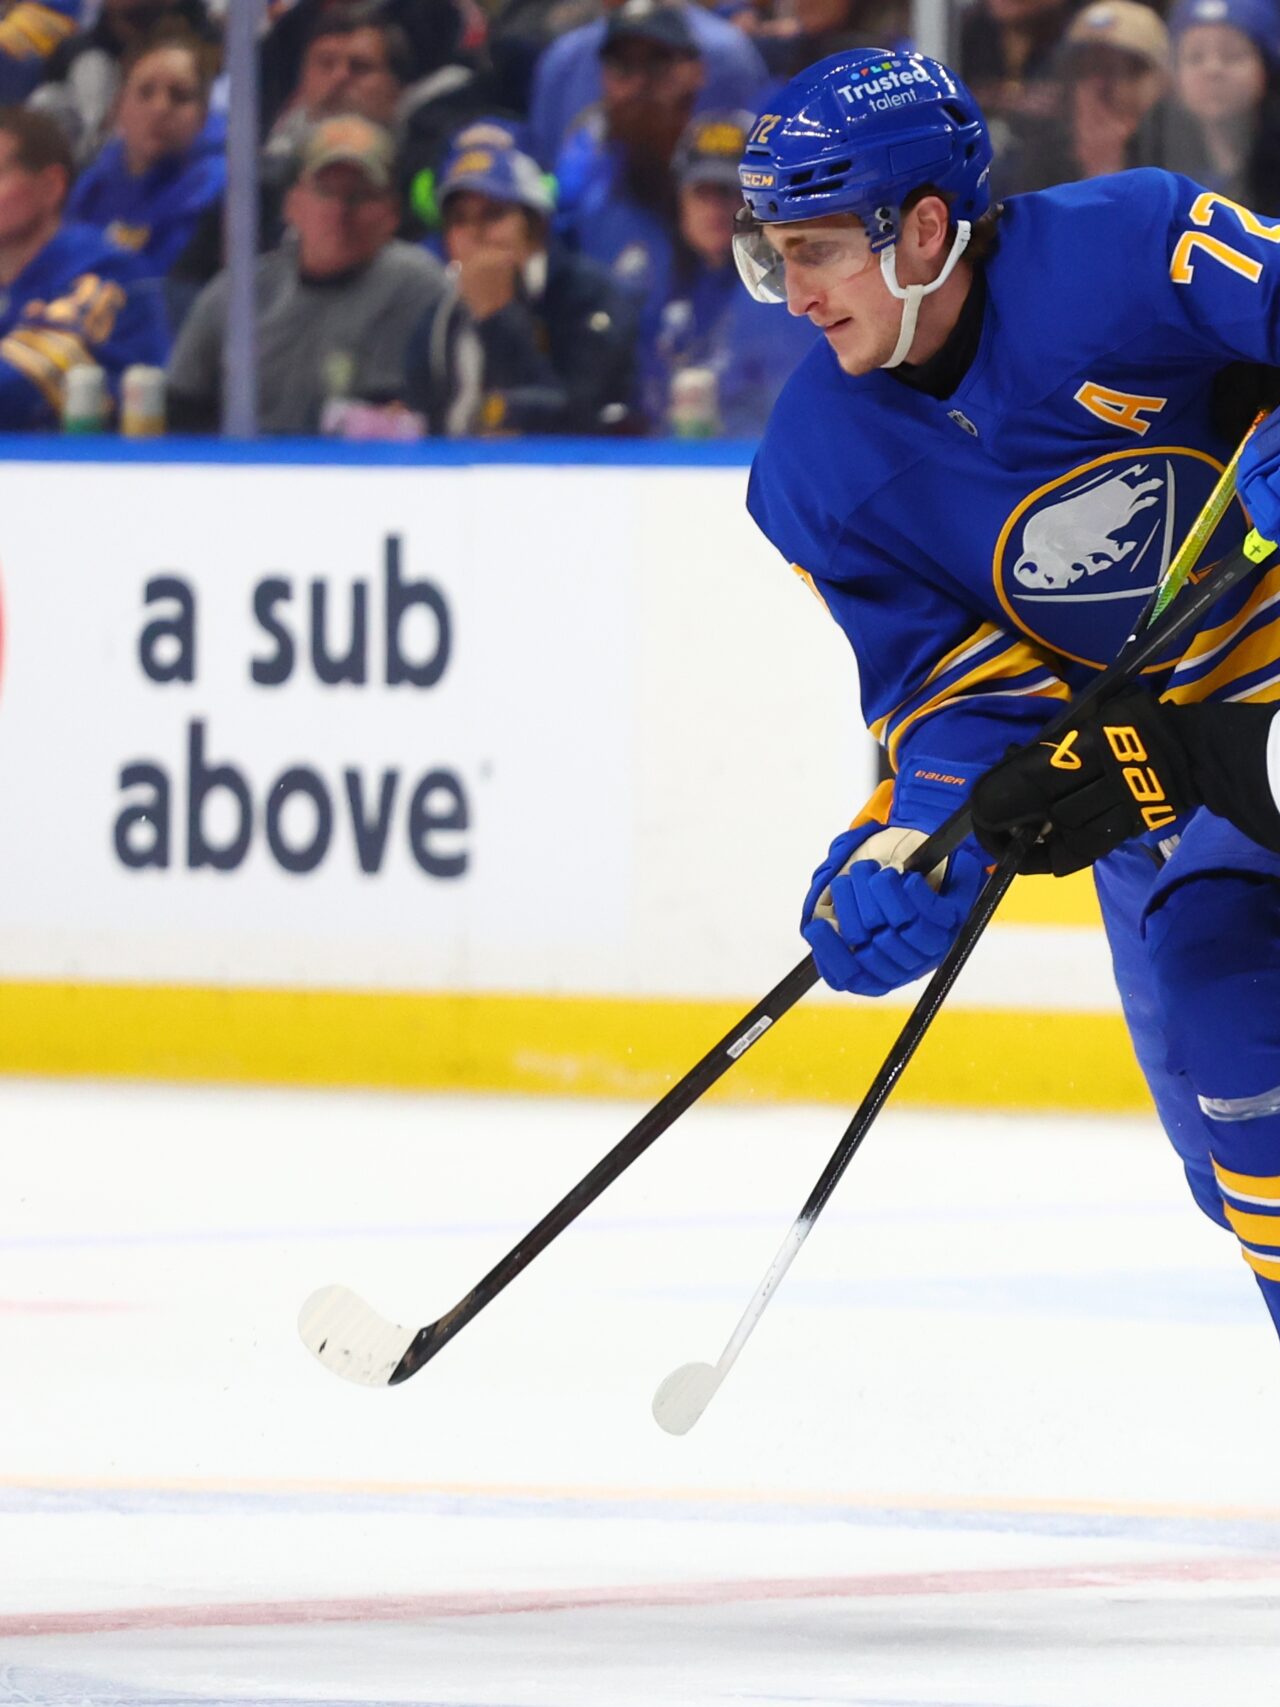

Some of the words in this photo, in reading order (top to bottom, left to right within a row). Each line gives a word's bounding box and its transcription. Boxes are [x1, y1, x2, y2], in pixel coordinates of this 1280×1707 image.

[838, 69, 930, 104] Trusted
[869, 88, 917, 113] talent
[1073, 381, 1168, 437] A
[138, 573, 197, 685] a
[250, 530, 454, 689] sub
[112, 714, 472, 879] above
